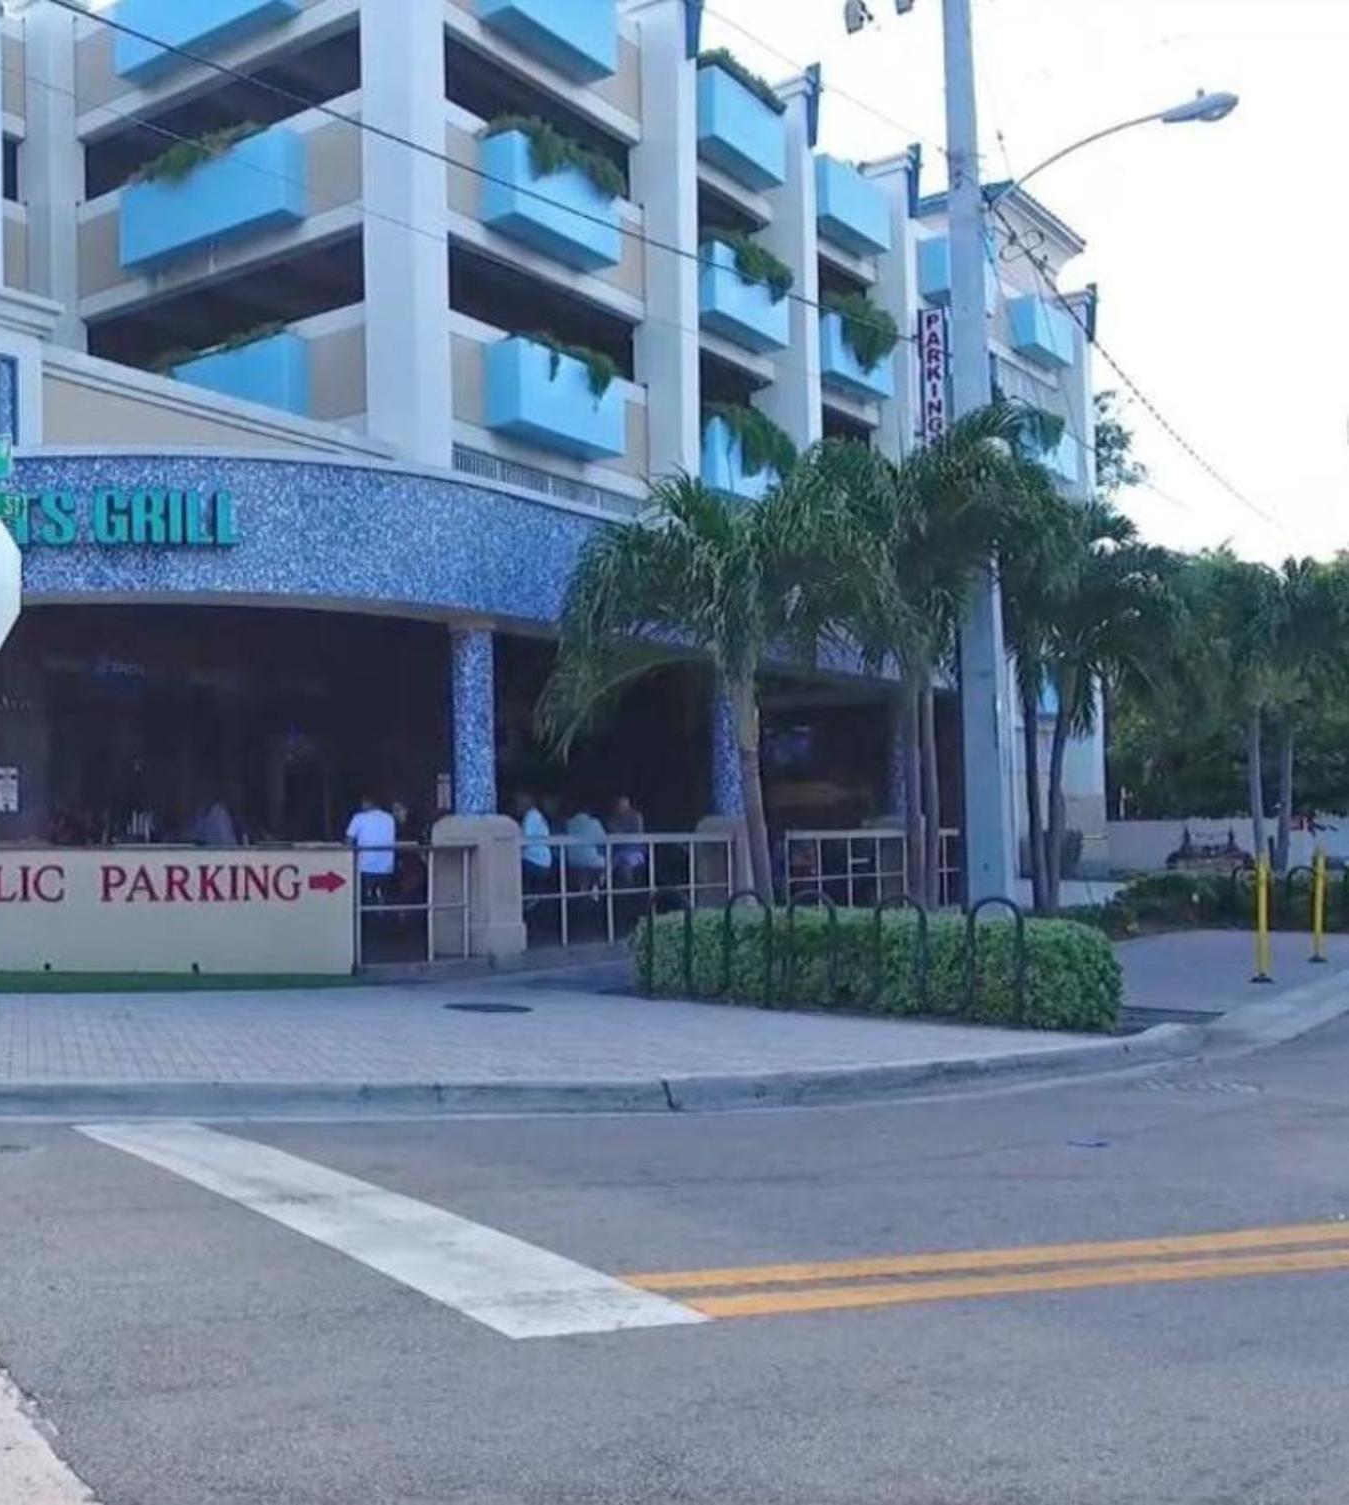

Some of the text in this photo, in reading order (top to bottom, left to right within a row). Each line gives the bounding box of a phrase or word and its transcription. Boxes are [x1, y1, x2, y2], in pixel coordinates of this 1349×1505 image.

[926, 313, 943, 433] PARKING
[3, 494, 21, 516] ST
[92, 486, 235, 546] GRILL
[100, 864, 302, 903] PARKING
